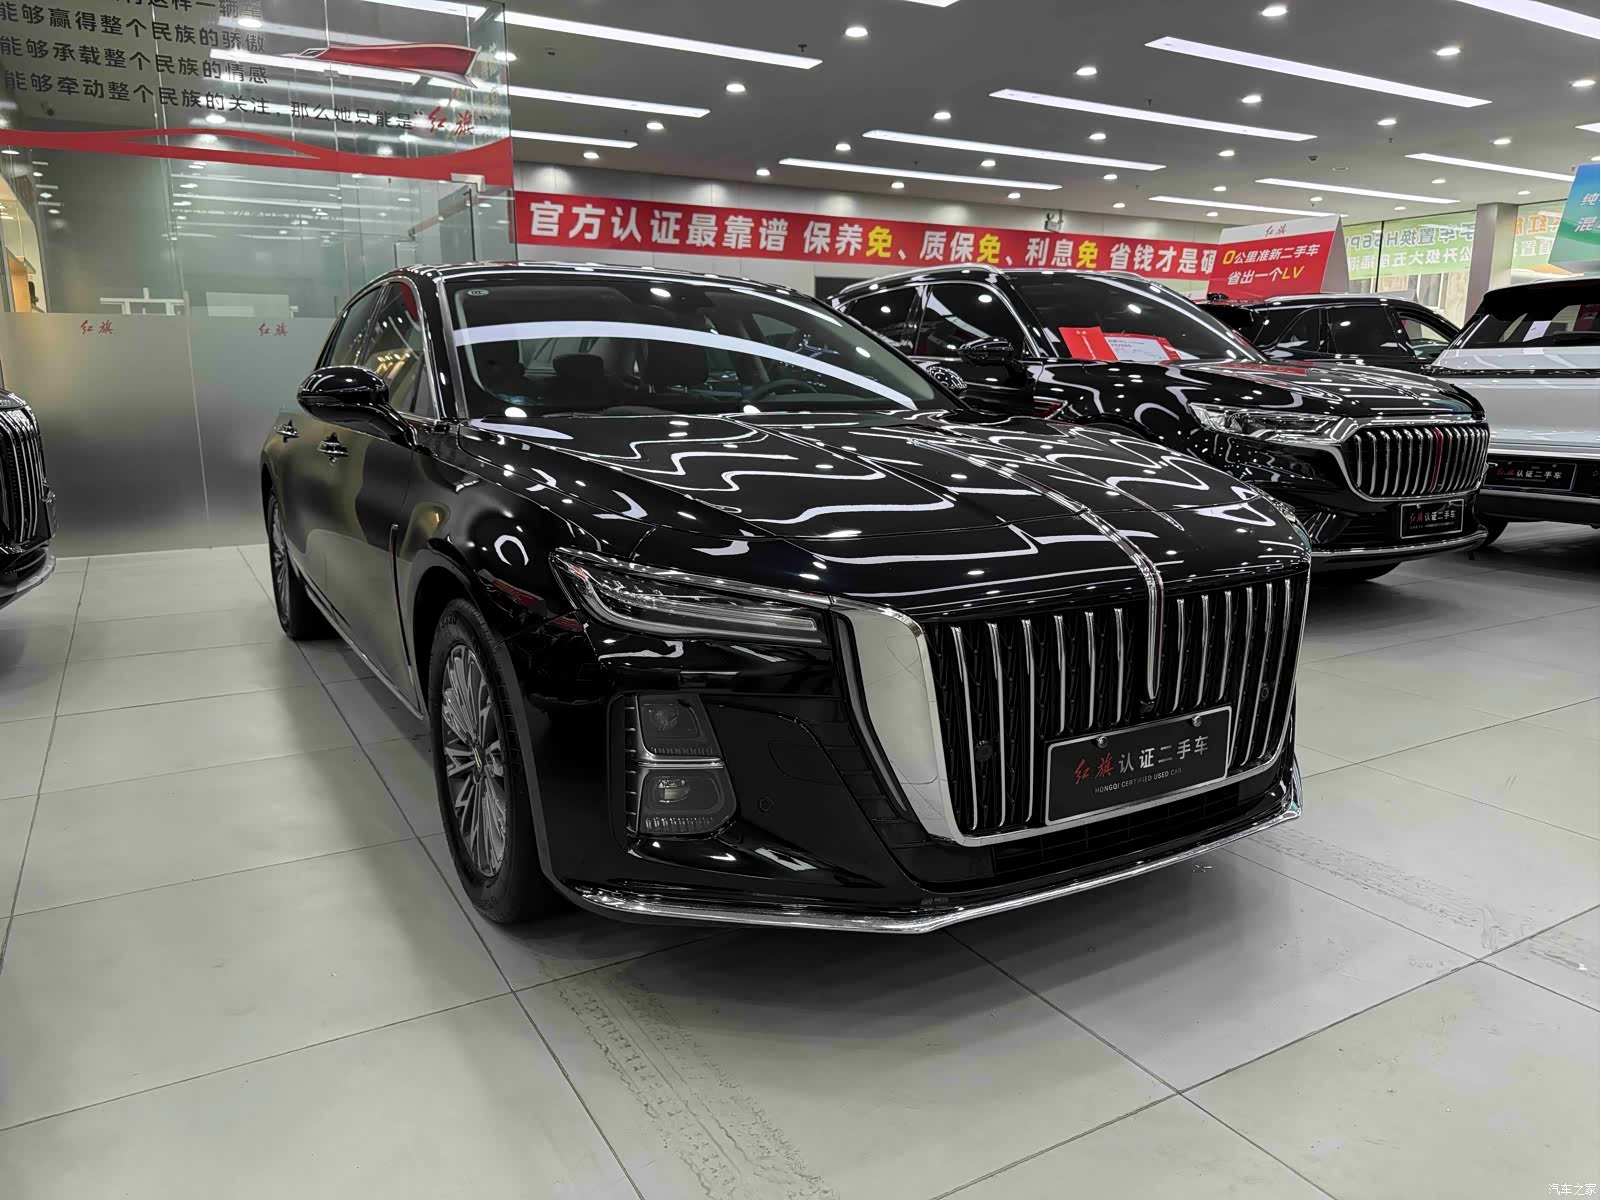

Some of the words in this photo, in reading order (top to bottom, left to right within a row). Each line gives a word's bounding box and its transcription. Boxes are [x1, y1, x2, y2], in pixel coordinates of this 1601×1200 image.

[0, 2, 265, 52] 能够赢得整个民族的骄傲
[0, 36, 268, 84] 能够承载整个民族的情感
[1580, 192, 1600, 206] 纯
[529, 200, 788, 252] 官方认证最靠谱
[1265, 223, 1287, 237] 红旗
[1227, 265, 1305, 286] 省出一个LV
[80, 319, 114, 334] 红旗
[258, 322, 288, 336] 红旗
[1095, 782, 1120, 793] HONGQI
[1121, 775, 1152, 789] CERTIFIED
[1153, 771, 1169, 780] USED
